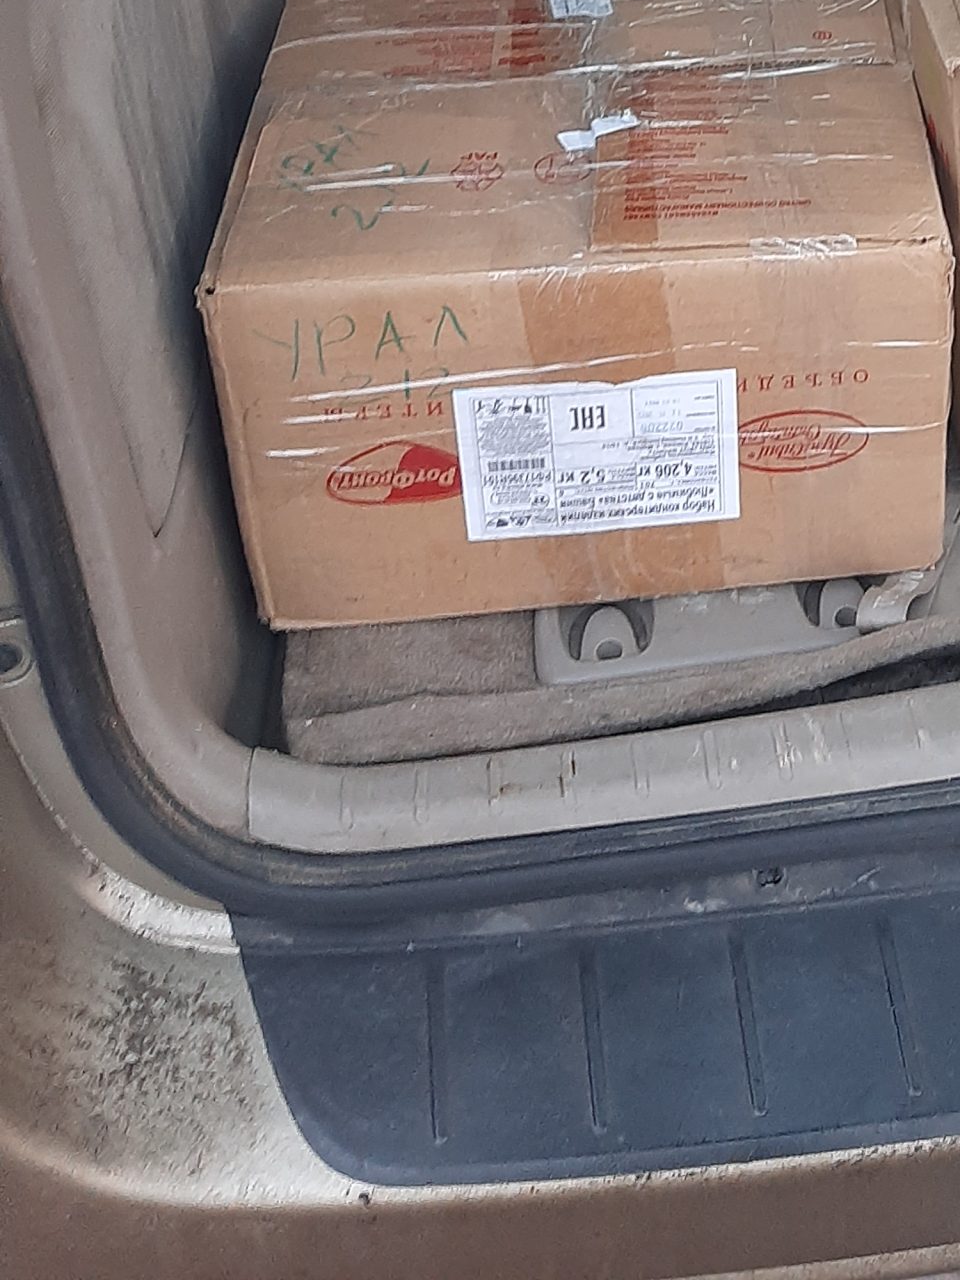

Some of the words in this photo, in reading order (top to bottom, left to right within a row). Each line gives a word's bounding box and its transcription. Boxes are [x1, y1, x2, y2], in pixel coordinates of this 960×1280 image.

[253, 304, 469, 383] УРАЛ
[738, 368, 869, 393] ОБЪЕДИ
[557, 471, 575, 483] кг
[580, 467, 606, 483] 5,2
[636, 464, 652, 477] кг
[655, 461, 693, 477] 4,206
[609, 501, 681, 518] кондитерских
[682, 498, 715, 514] Набор
